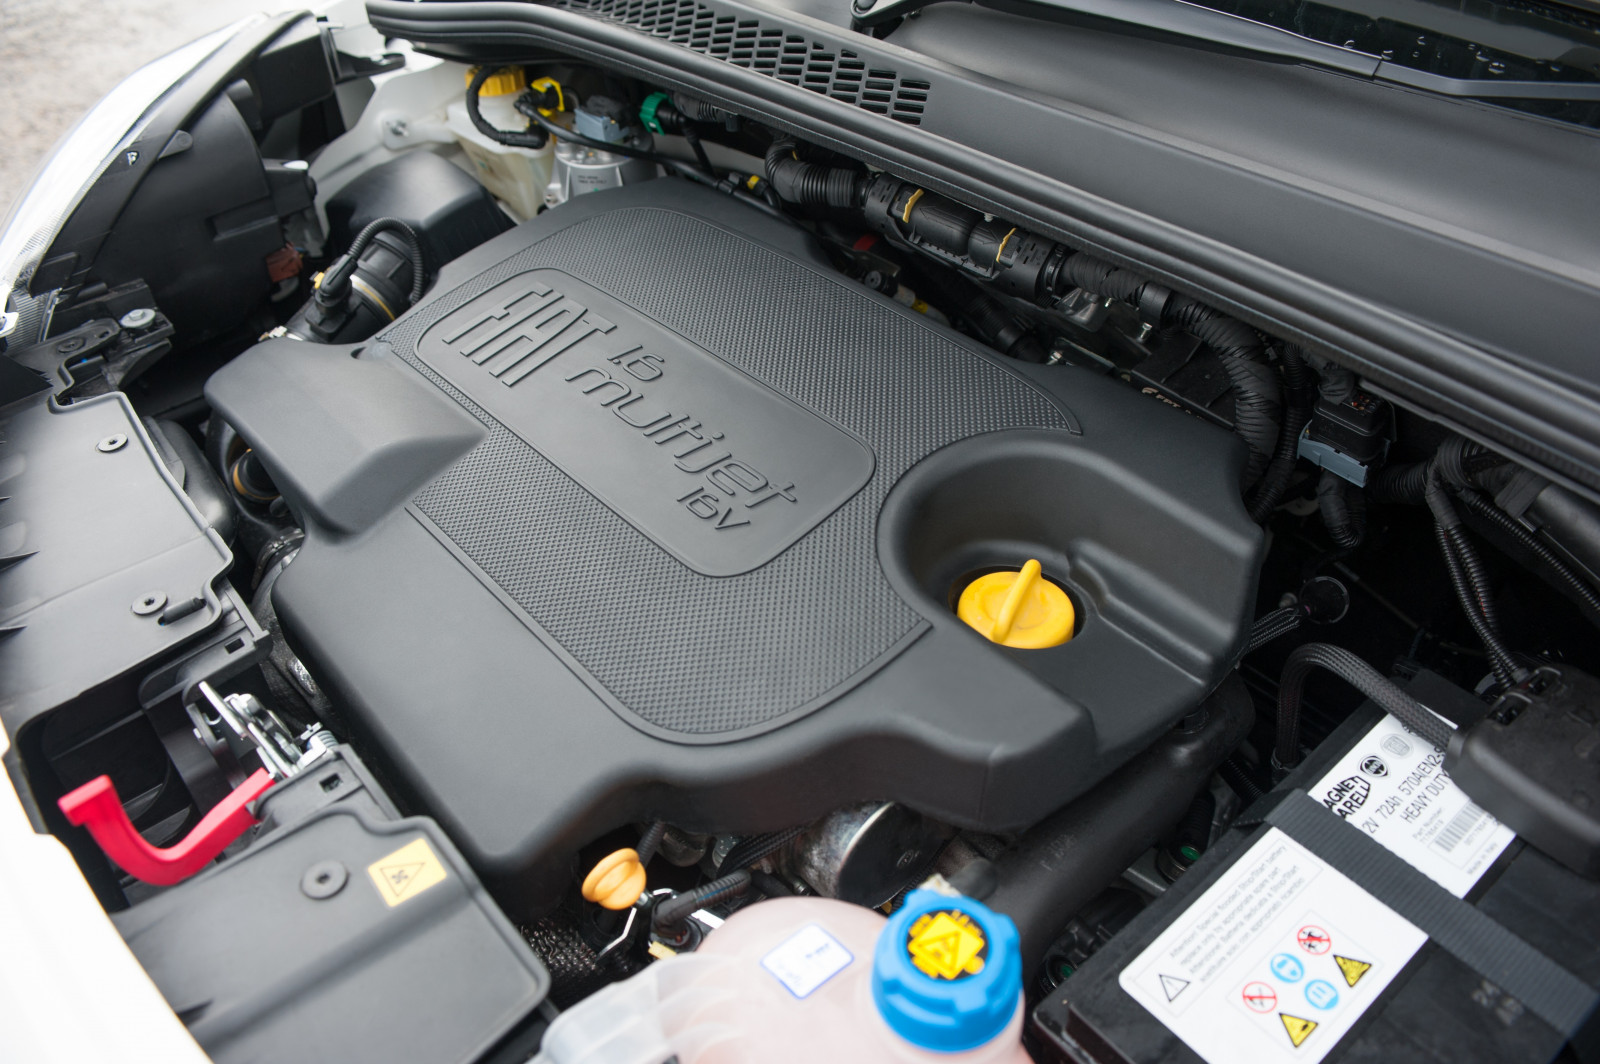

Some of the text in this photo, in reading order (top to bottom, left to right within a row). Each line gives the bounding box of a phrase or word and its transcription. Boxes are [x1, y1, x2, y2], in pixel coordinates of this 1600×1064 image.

[442, 282, 617, 387] FIAT
[607, 343, 665, 381] 1.6
[565, 366, 798, 509] multijet
[676, 486, 751, 530] 16V
[1323, 776, 1366, 809] AGNETI
[1336, 779, 1370, 819] ARELLI
[1399, 790, 1432, 823] HEAVY
[1362, 817, 1380, 833] 2V
[1374, 795, 1403, 819] 72Ah
